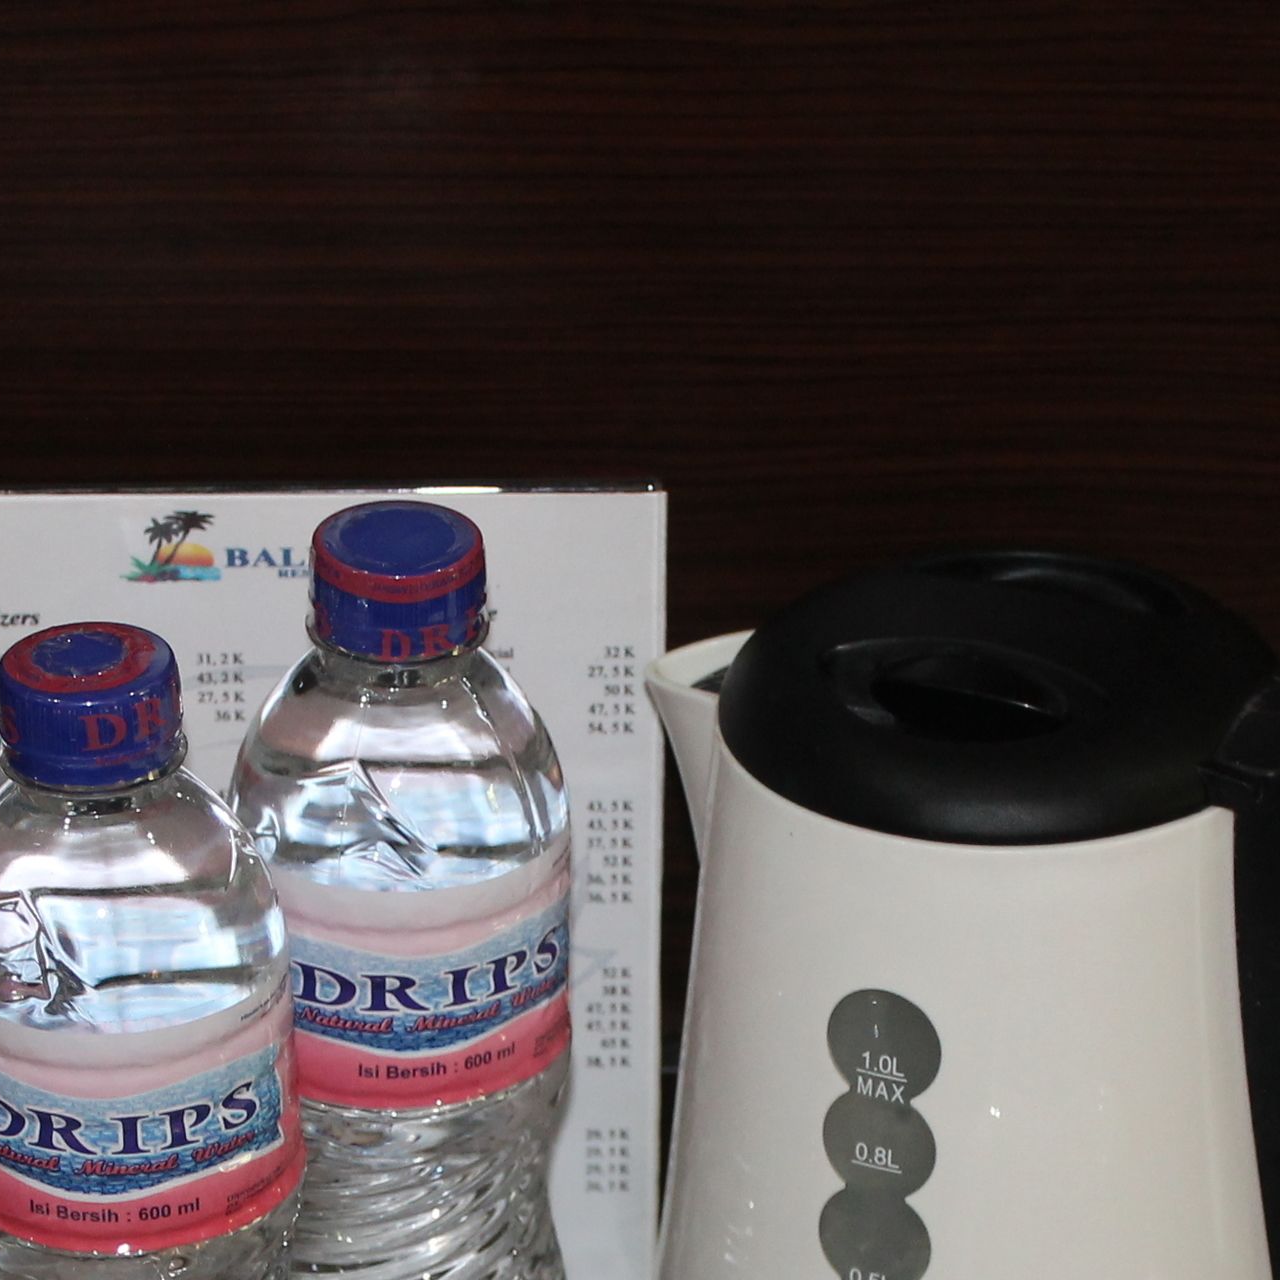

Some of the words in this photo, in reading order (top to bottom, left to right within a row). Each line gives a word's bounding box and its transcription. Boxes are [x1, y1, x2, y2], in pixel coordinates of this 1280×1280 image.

[233, 652, 245, 665] K
[623, 646, 636, 659] K
[233, 671, 244, 684] K
[623, 665, 635, 678] K
[623, 684, 635, 696] K
[234, 691, 245, 703] K
[234, 709, 246, 721] K
[624, 703, 636, 716] K
[623, 722, 635, 734] K
[291, 922, 565, 1012] DRIPS
[296, 1006, 394, 1034] Natural
[406, 1000, 501, 1033] Mineral
[357, 1063, 380, 1078] Isi
[386, 1061, 447, 1079] Bersih
[463, 1053, 493, 1070] 600
[496, 1041, 516, 1061] ml
[862, 1051, 905, 1078] 1.0L
[857, 1075, 905, 1104] MAX
[74, 1153, 179, 1178] Mineral
[191, 1131, 256, 1163] Water
[855, 1142, 900, 1169] 0.8L
[30, 1199, 50, 1216] Isi
[56, 1206, 119, 1223] Bersih
[138, 1205, 172, 1221] 600
[178, 1198, 200, 1216] ml
